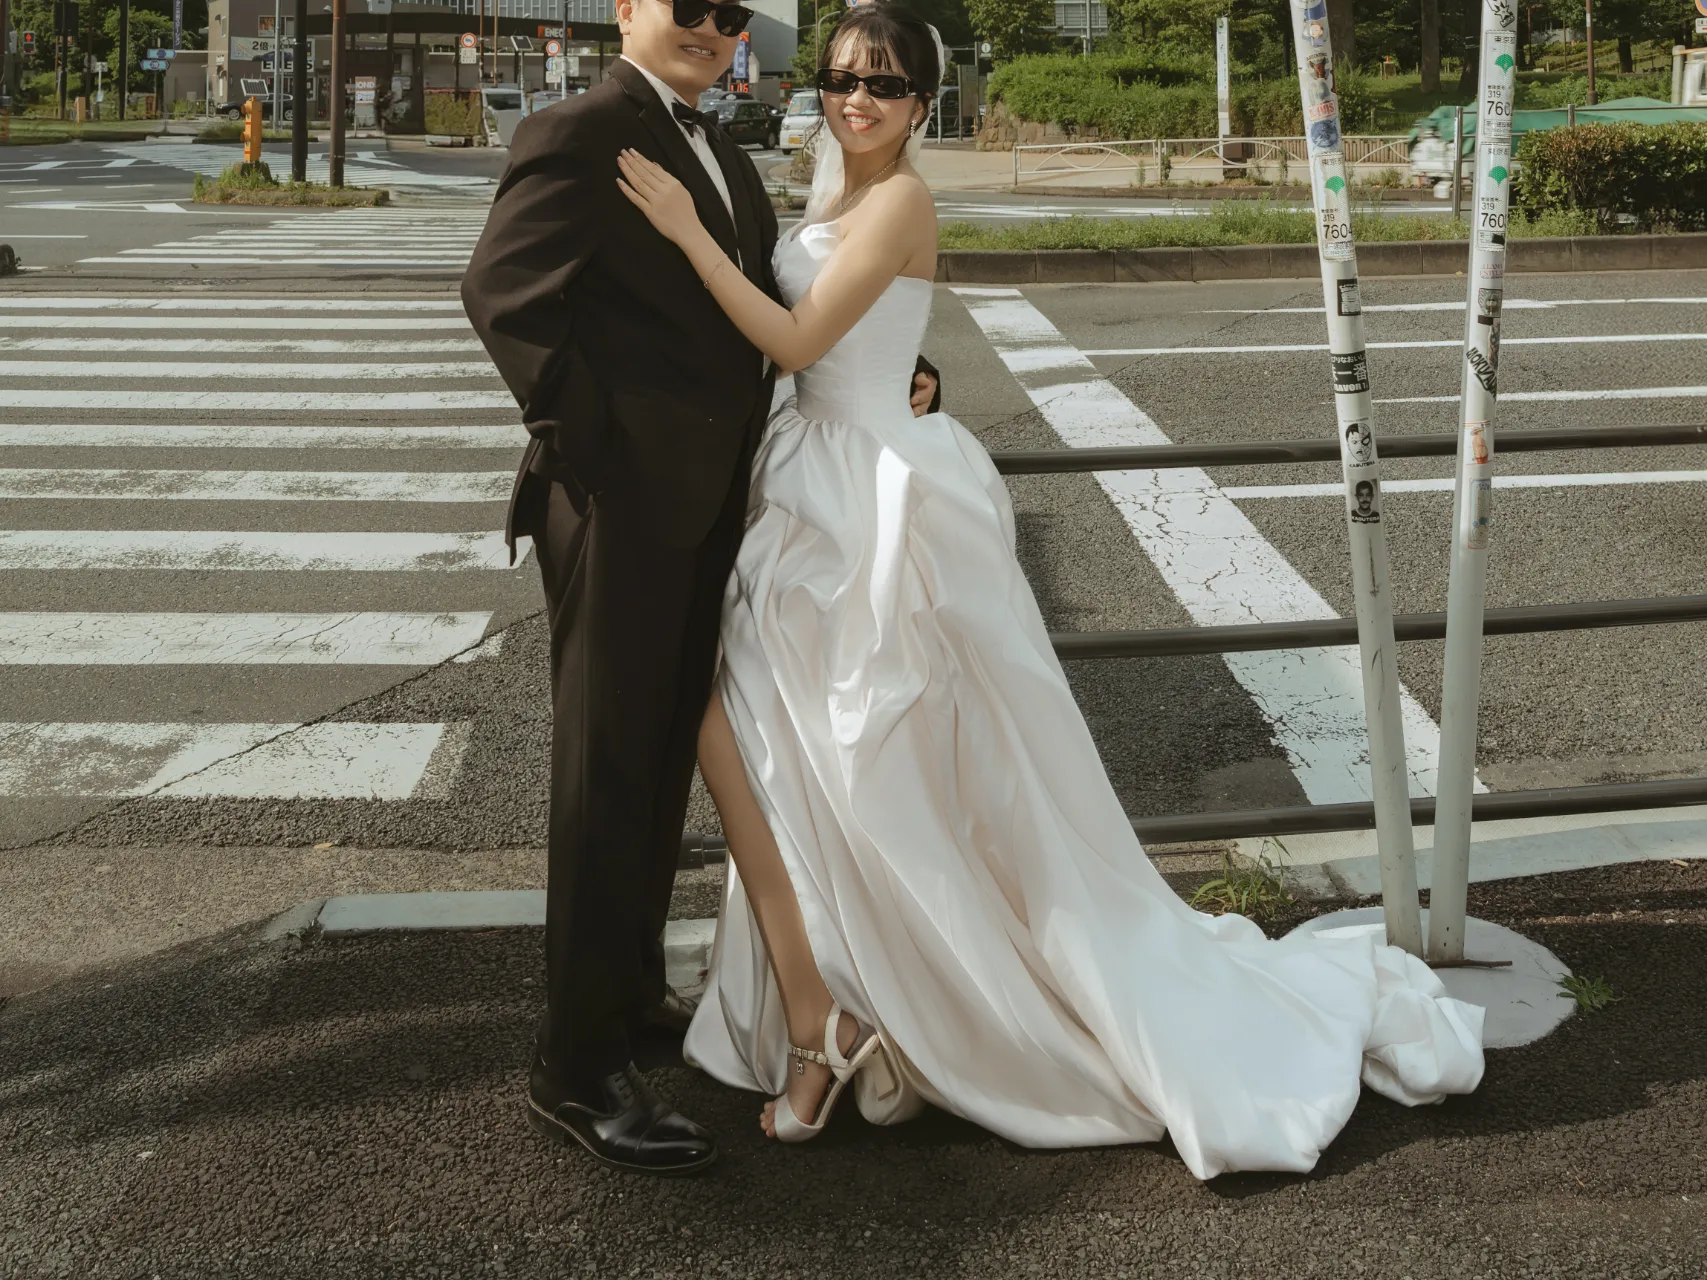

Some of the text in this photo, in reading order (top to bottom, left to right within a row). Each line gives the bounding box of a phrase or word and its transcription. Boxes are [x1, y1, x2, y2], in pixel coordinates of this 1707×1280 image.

[544, 27, 564, 38] ENEO
[263, 61, 313, 70] EES
[1487, 90, 1501, 99] 319
[1487, 100, 1513, 117] 760
[1481, 202, 1495, 211] 319
[1481, 212, 1507, 229] 760
